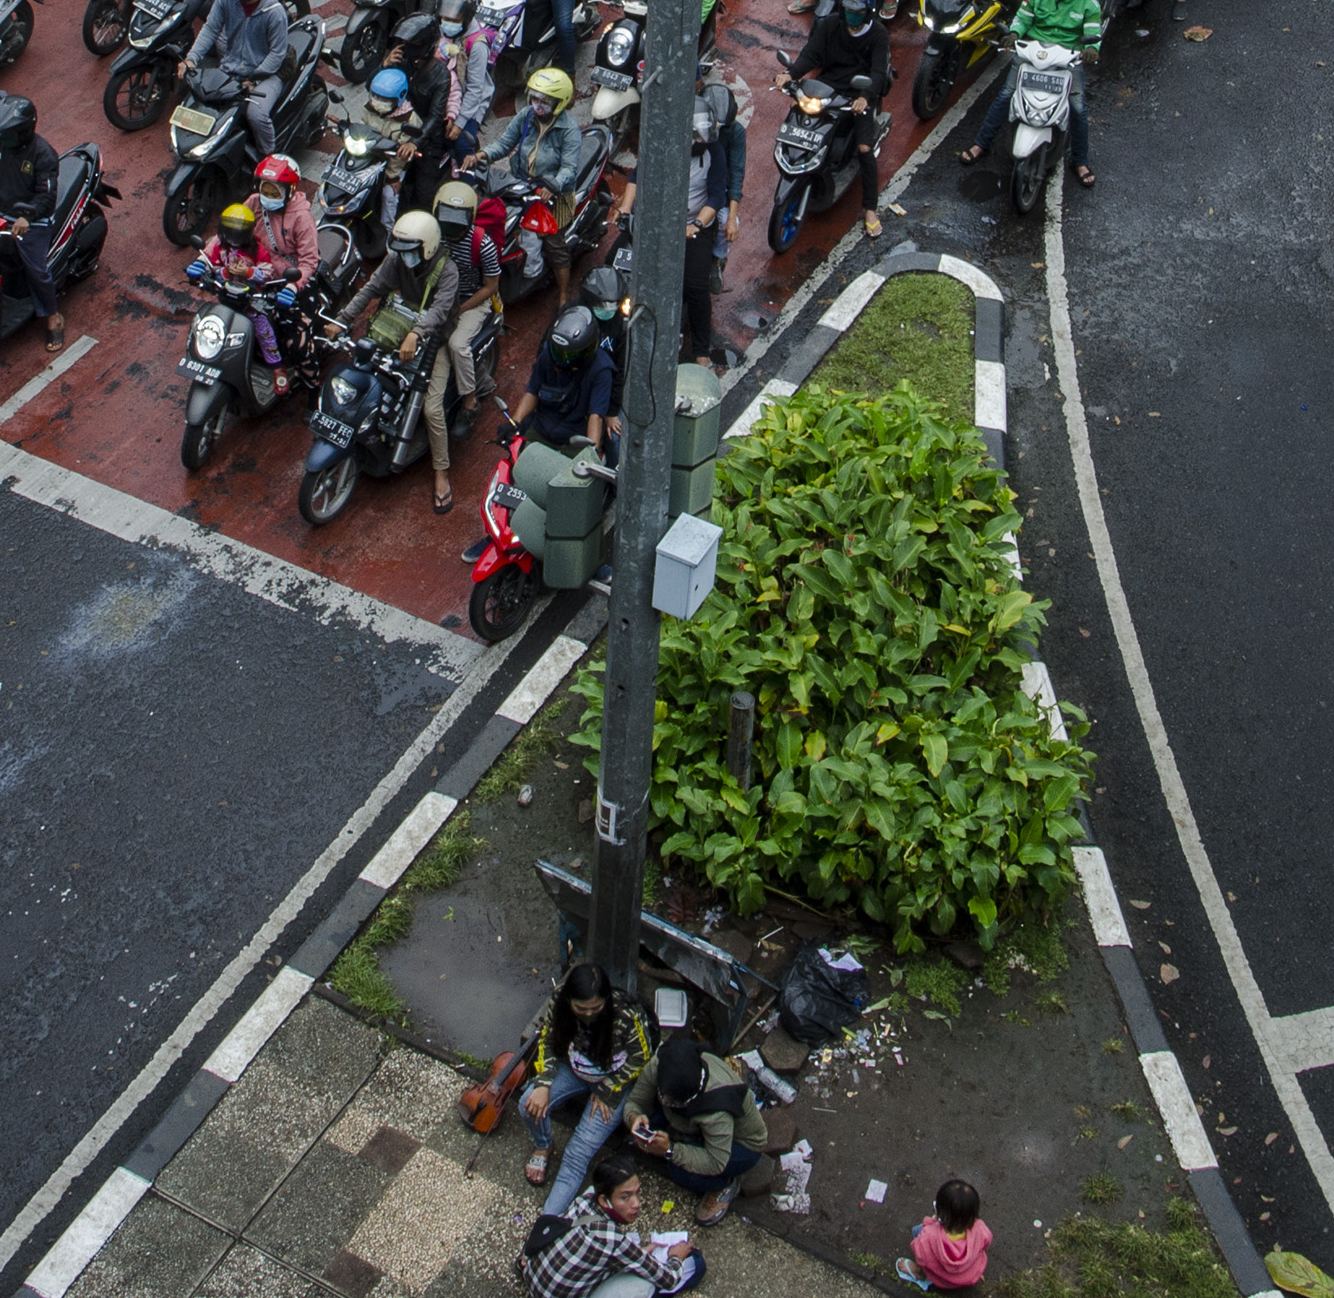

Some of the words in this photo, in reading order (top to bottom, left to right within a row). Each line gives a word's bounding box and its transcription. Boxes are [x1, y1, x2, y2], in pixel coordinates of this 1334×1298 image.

[179, 357, 186, 367] D
[186, 360, 205, 373] 6301
[338, 424, 353, 438] FEC
[497, 483, 504, 493] D
